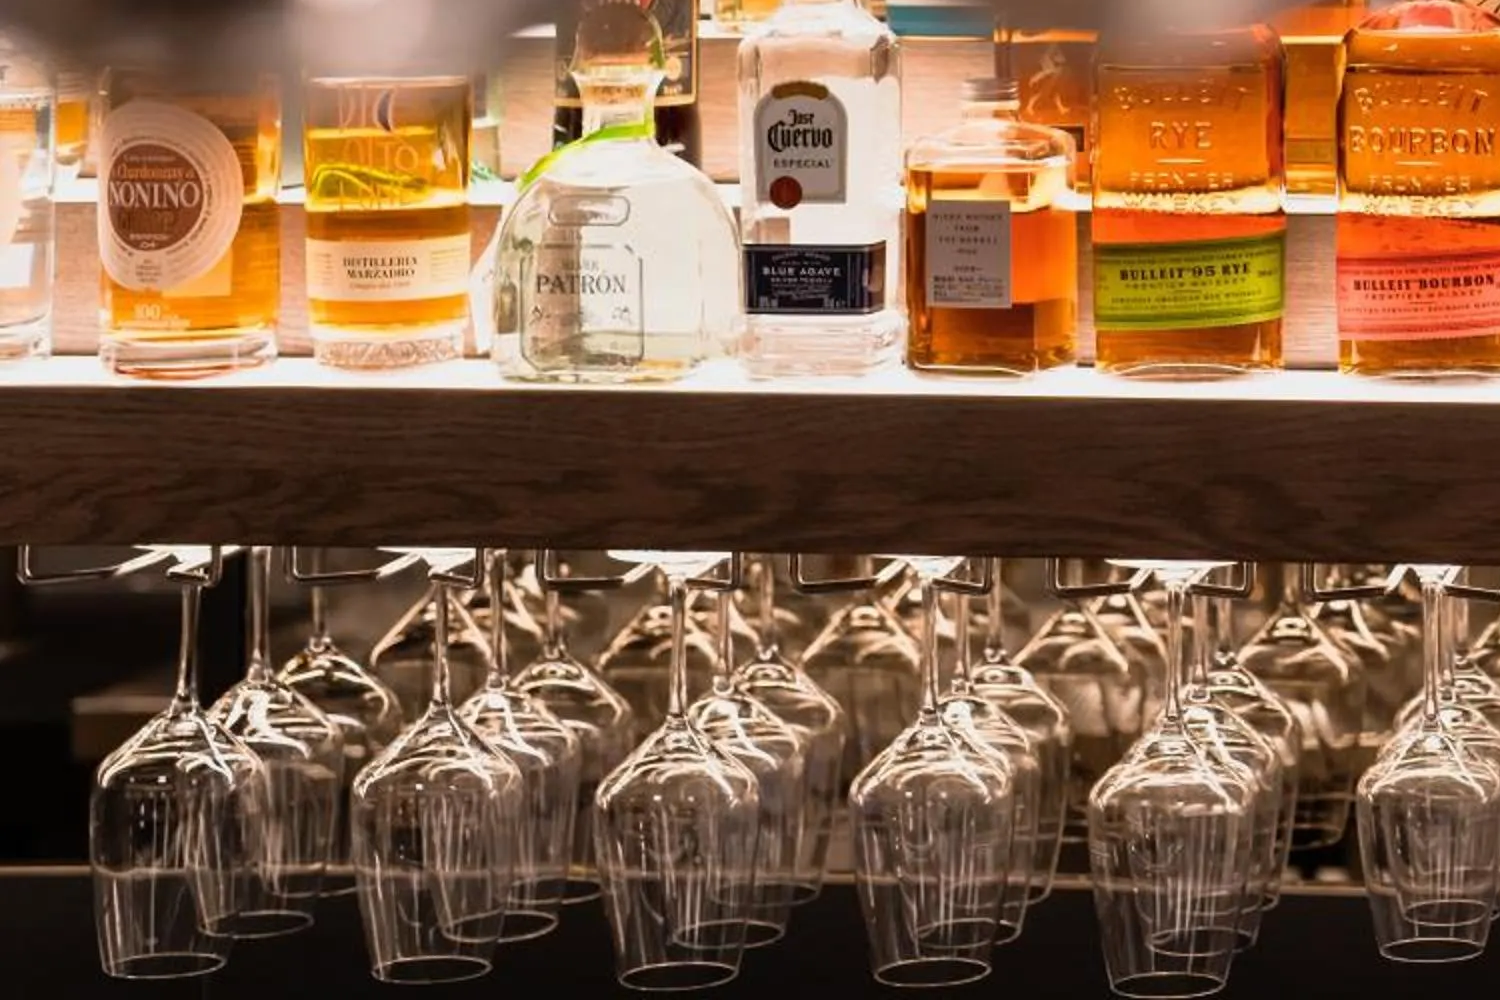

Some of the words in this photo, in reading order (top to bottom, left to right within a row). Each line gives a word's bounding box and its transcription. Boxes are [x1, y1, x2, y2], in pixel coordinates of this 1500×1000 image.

[767, 119, 833, 153] Cuervo
[1150, 121, 1212, 149] RYE
[1349, 125, 1496, 156] BOURBON
[773, 158, 832, 169] ESPECIAL
[108, 180, 200, 209] NONINO
[761, 266, 796, 277] BLUE
[799, 266, 842, 277] AGAVE
[1353, 279, 1412, 292] BULLEIT
[1418, 273, 1496, 290] BOURBON
